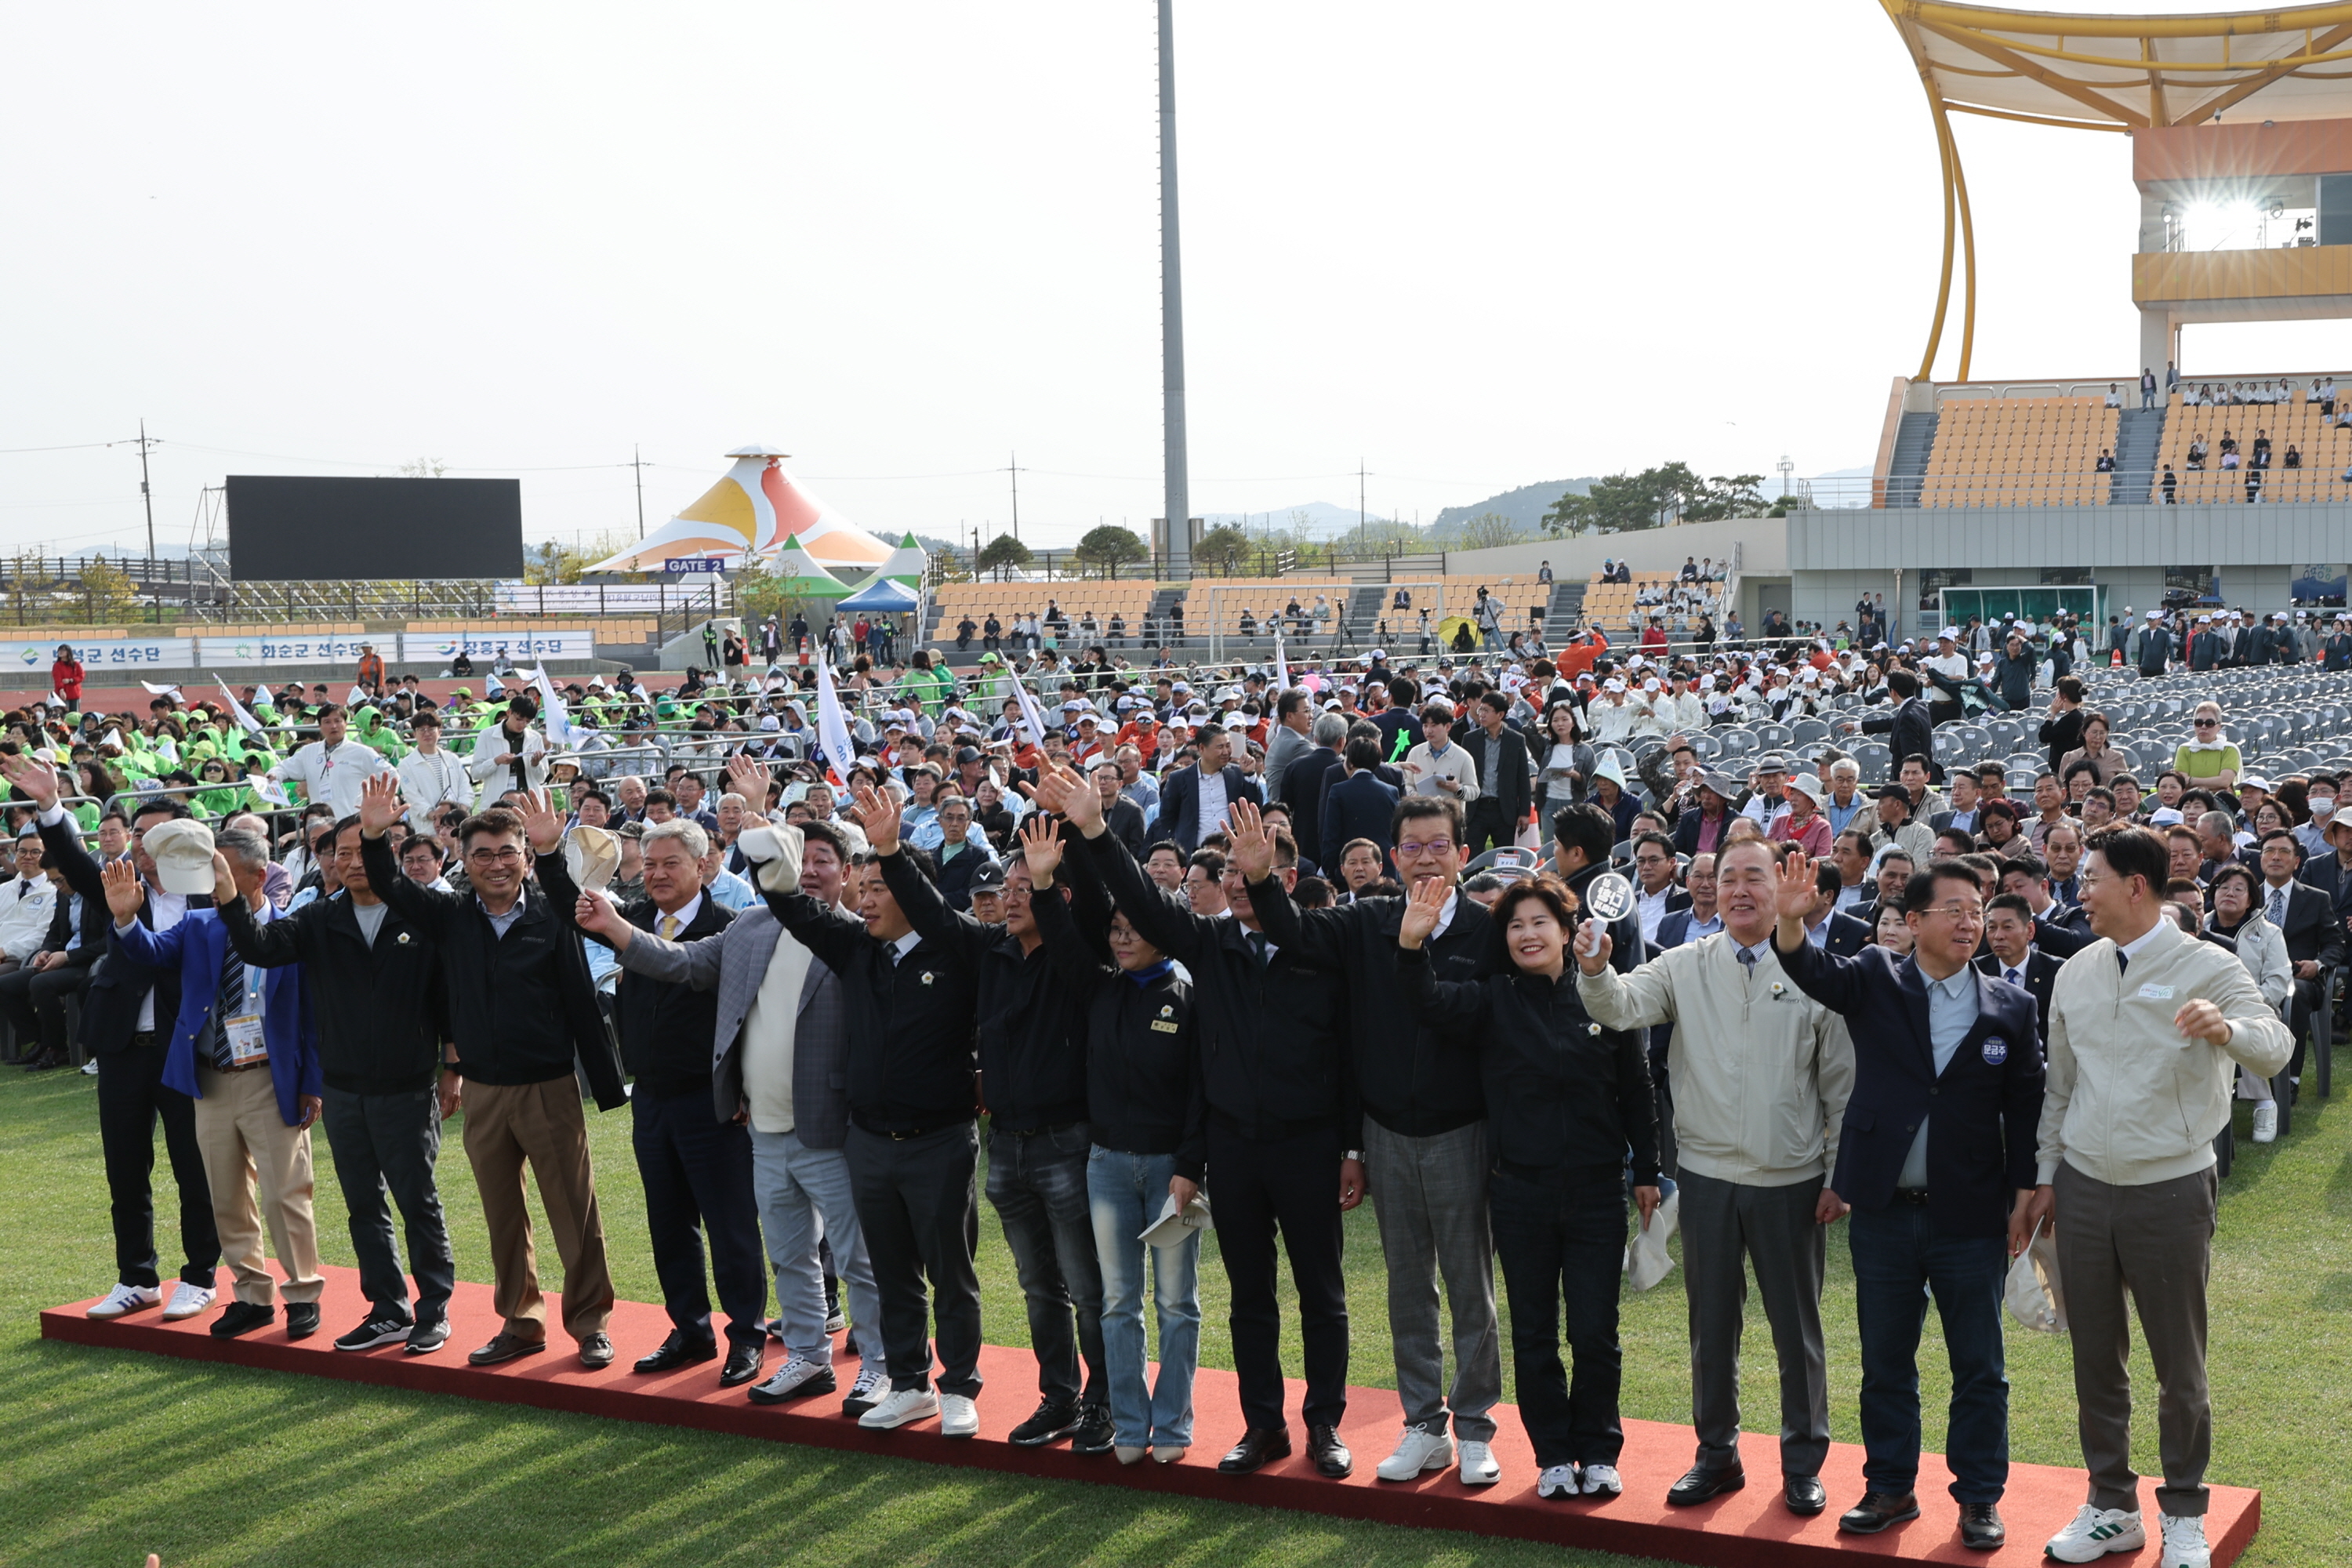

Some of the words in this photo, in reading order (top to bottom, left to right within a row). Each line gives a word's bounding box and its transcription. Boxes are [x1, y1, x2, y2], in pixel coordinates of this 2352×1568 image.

[669, 560, 706, 572] GATE
[712, 560, 721, 572] 2
[110, 647, 160, 662] 선수단
[261, 643, 309, 659] 화순군
[463, 641, 510, 655] 장흥군
[516, 639, 562, 654] 선수단
[1984, 1044, 2005, 1055] 문금주
